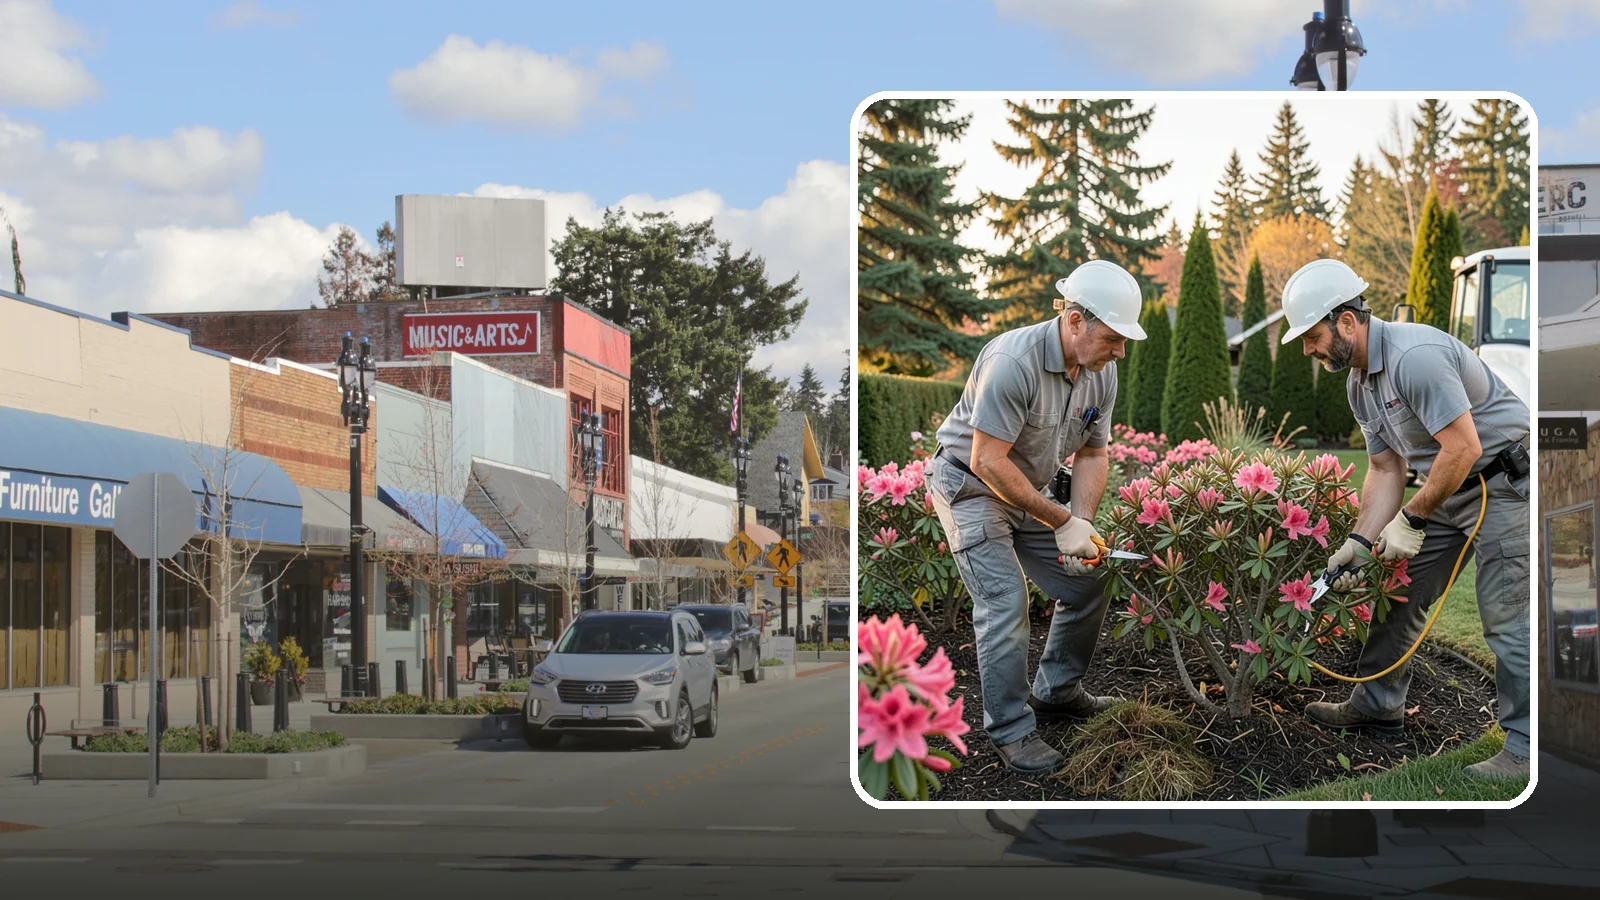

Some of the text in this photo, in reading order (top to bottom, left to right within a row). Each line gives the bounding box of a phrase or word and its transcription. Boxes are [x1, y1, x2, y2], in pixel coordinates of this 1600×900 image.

[0, 471, 122, 519] Furniture Gal
[454, 563, 479, 574] SUSHI
